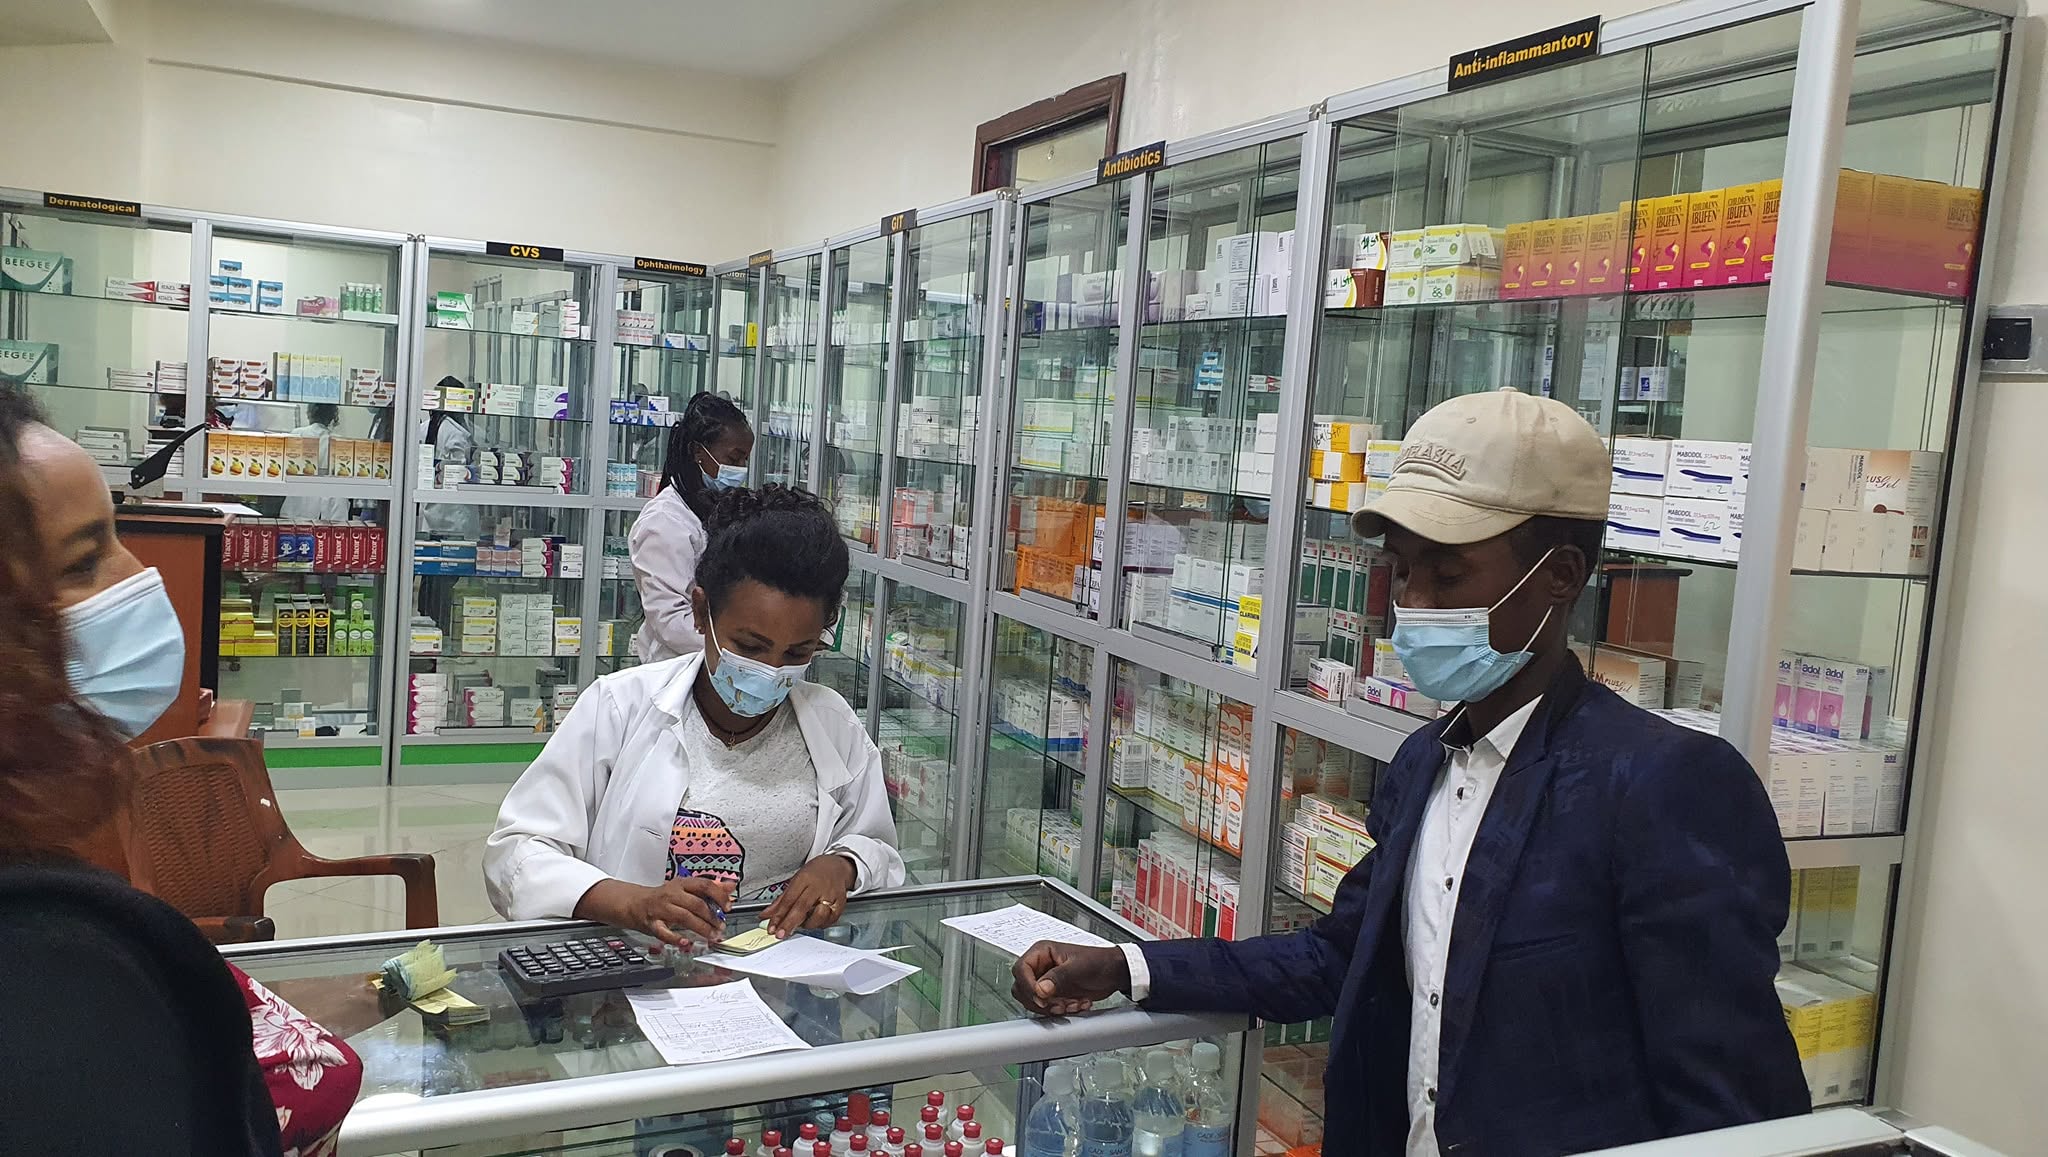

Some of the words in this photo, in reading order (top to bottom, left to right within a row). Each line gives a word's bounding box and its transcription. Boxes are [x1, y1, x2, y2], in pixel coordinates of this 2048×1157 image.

[1453, 30, 1595, 79] Anti-inflammantory
[1102, 148, 1161, 178] Antibiotics
[48, 196, 136, 214] Dermatological
[890, 213, 905, 231] GIT
[509, 245, 540, 259] CVS
[4, 257, 51, 270] BEEGEE
[636, 258, 706, 276] Ophthalmology
[240, 537, 250, 563] Vitacor
[260, 538, 269, 564] Vitacor
[315, 539, 325, 565] Vitacor
[333, 539, 342, 565] Vitacor
[351, 539, 360, 565] Vitacor
[369, 540, 378, 565] Vitacor
[1802, 663, 1821, 675] adol
[1825, 667, 1844, 680] adol
[1366, 684, 1382, 698] adol
